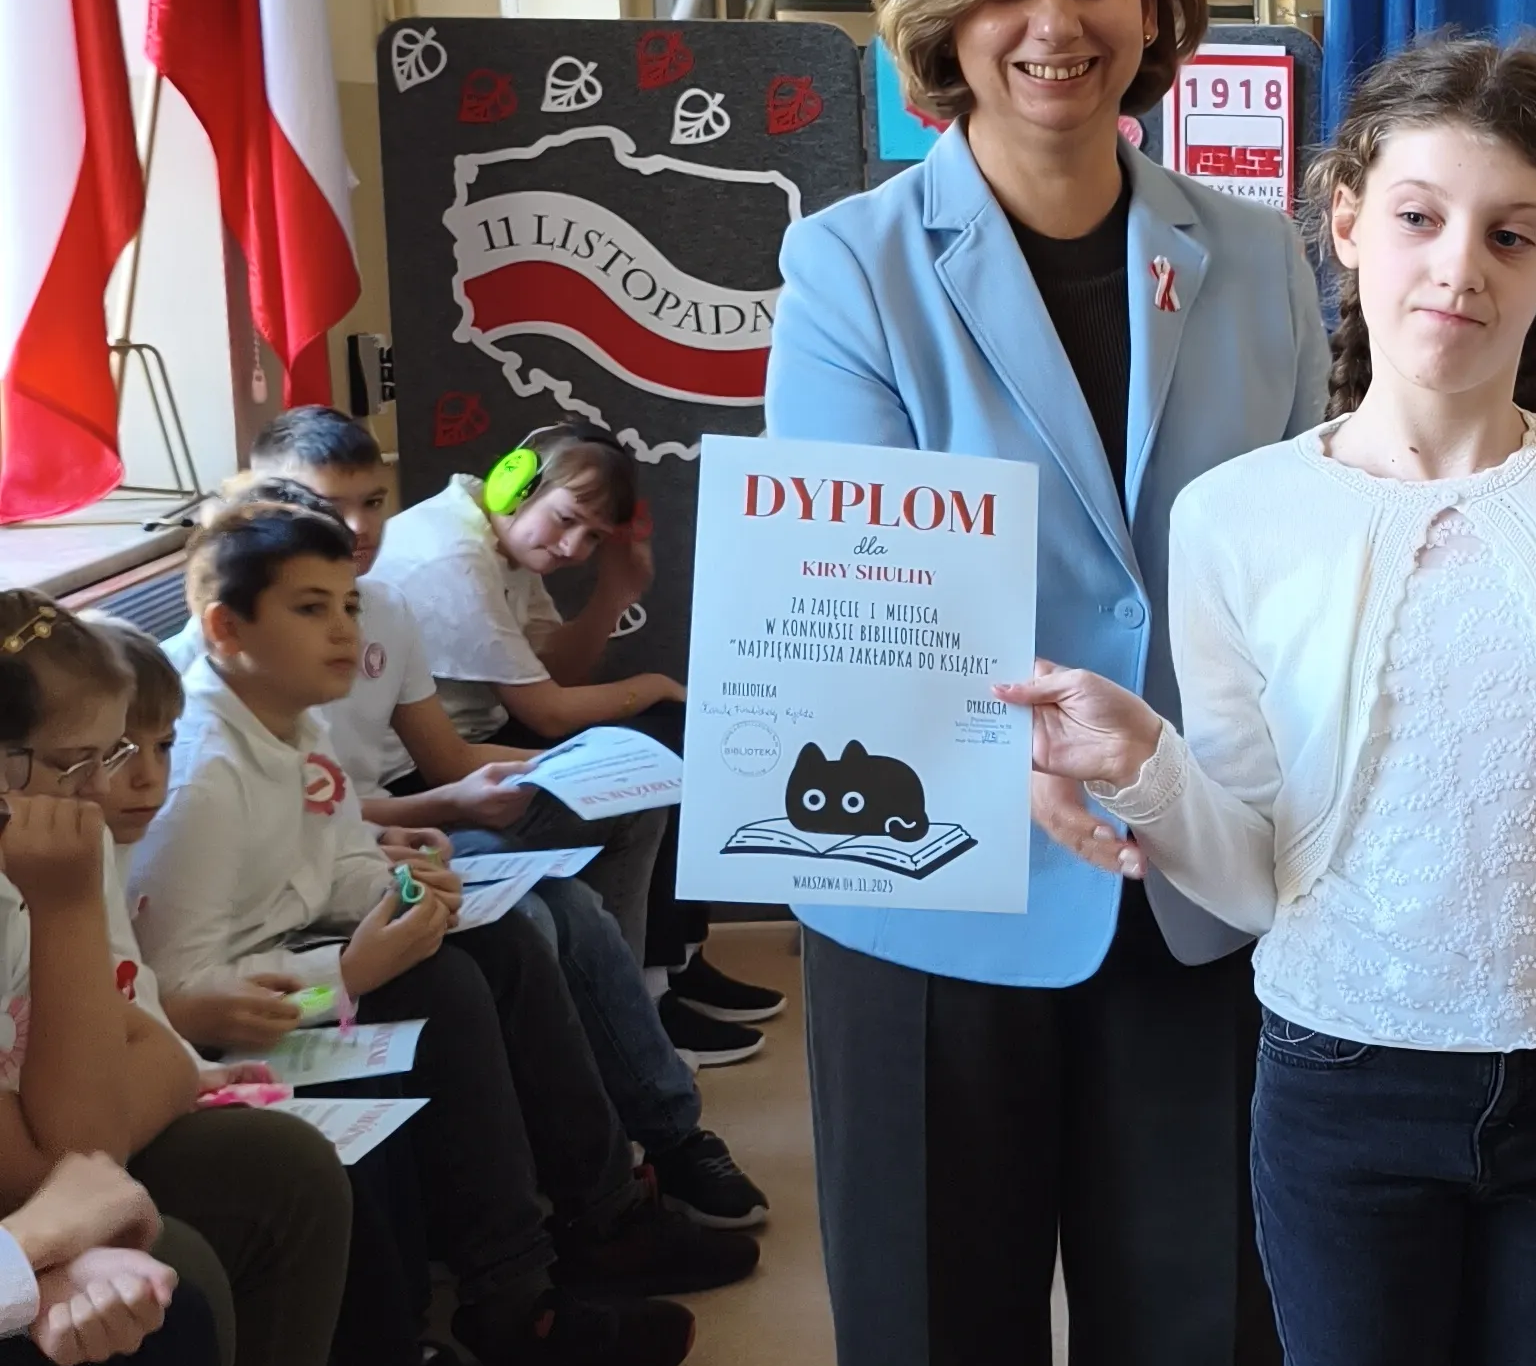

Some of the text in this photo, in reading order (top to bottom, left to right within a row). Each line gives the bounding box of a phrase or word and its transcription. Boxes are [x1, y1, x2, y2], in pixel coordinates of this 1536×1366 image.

[1185, 78, 1282, 110] 1918
[1208, 185, 1284, 198] YSKANIE
[477, 213, 775, 336] 11 LISTOPADA
[744, 473, 997, 536] DYPLOM
[853, 535, 888, 555] dla
[802, 560, 937, 585] KIRY SHULHY
[791, 597, 939, 624] ZA ZAJĘCIE I MIEJSCA
[766, 618, 960, 649] W KONKURSIE BIBILIOTECZNYM
[849, 647, 912, 668] ZAKŁADKA
[919, 652, 935, 670] DO
[966, 699, 1007, 715] DYREKCJA
[793, 875, 840, 891] WARSZAWA
